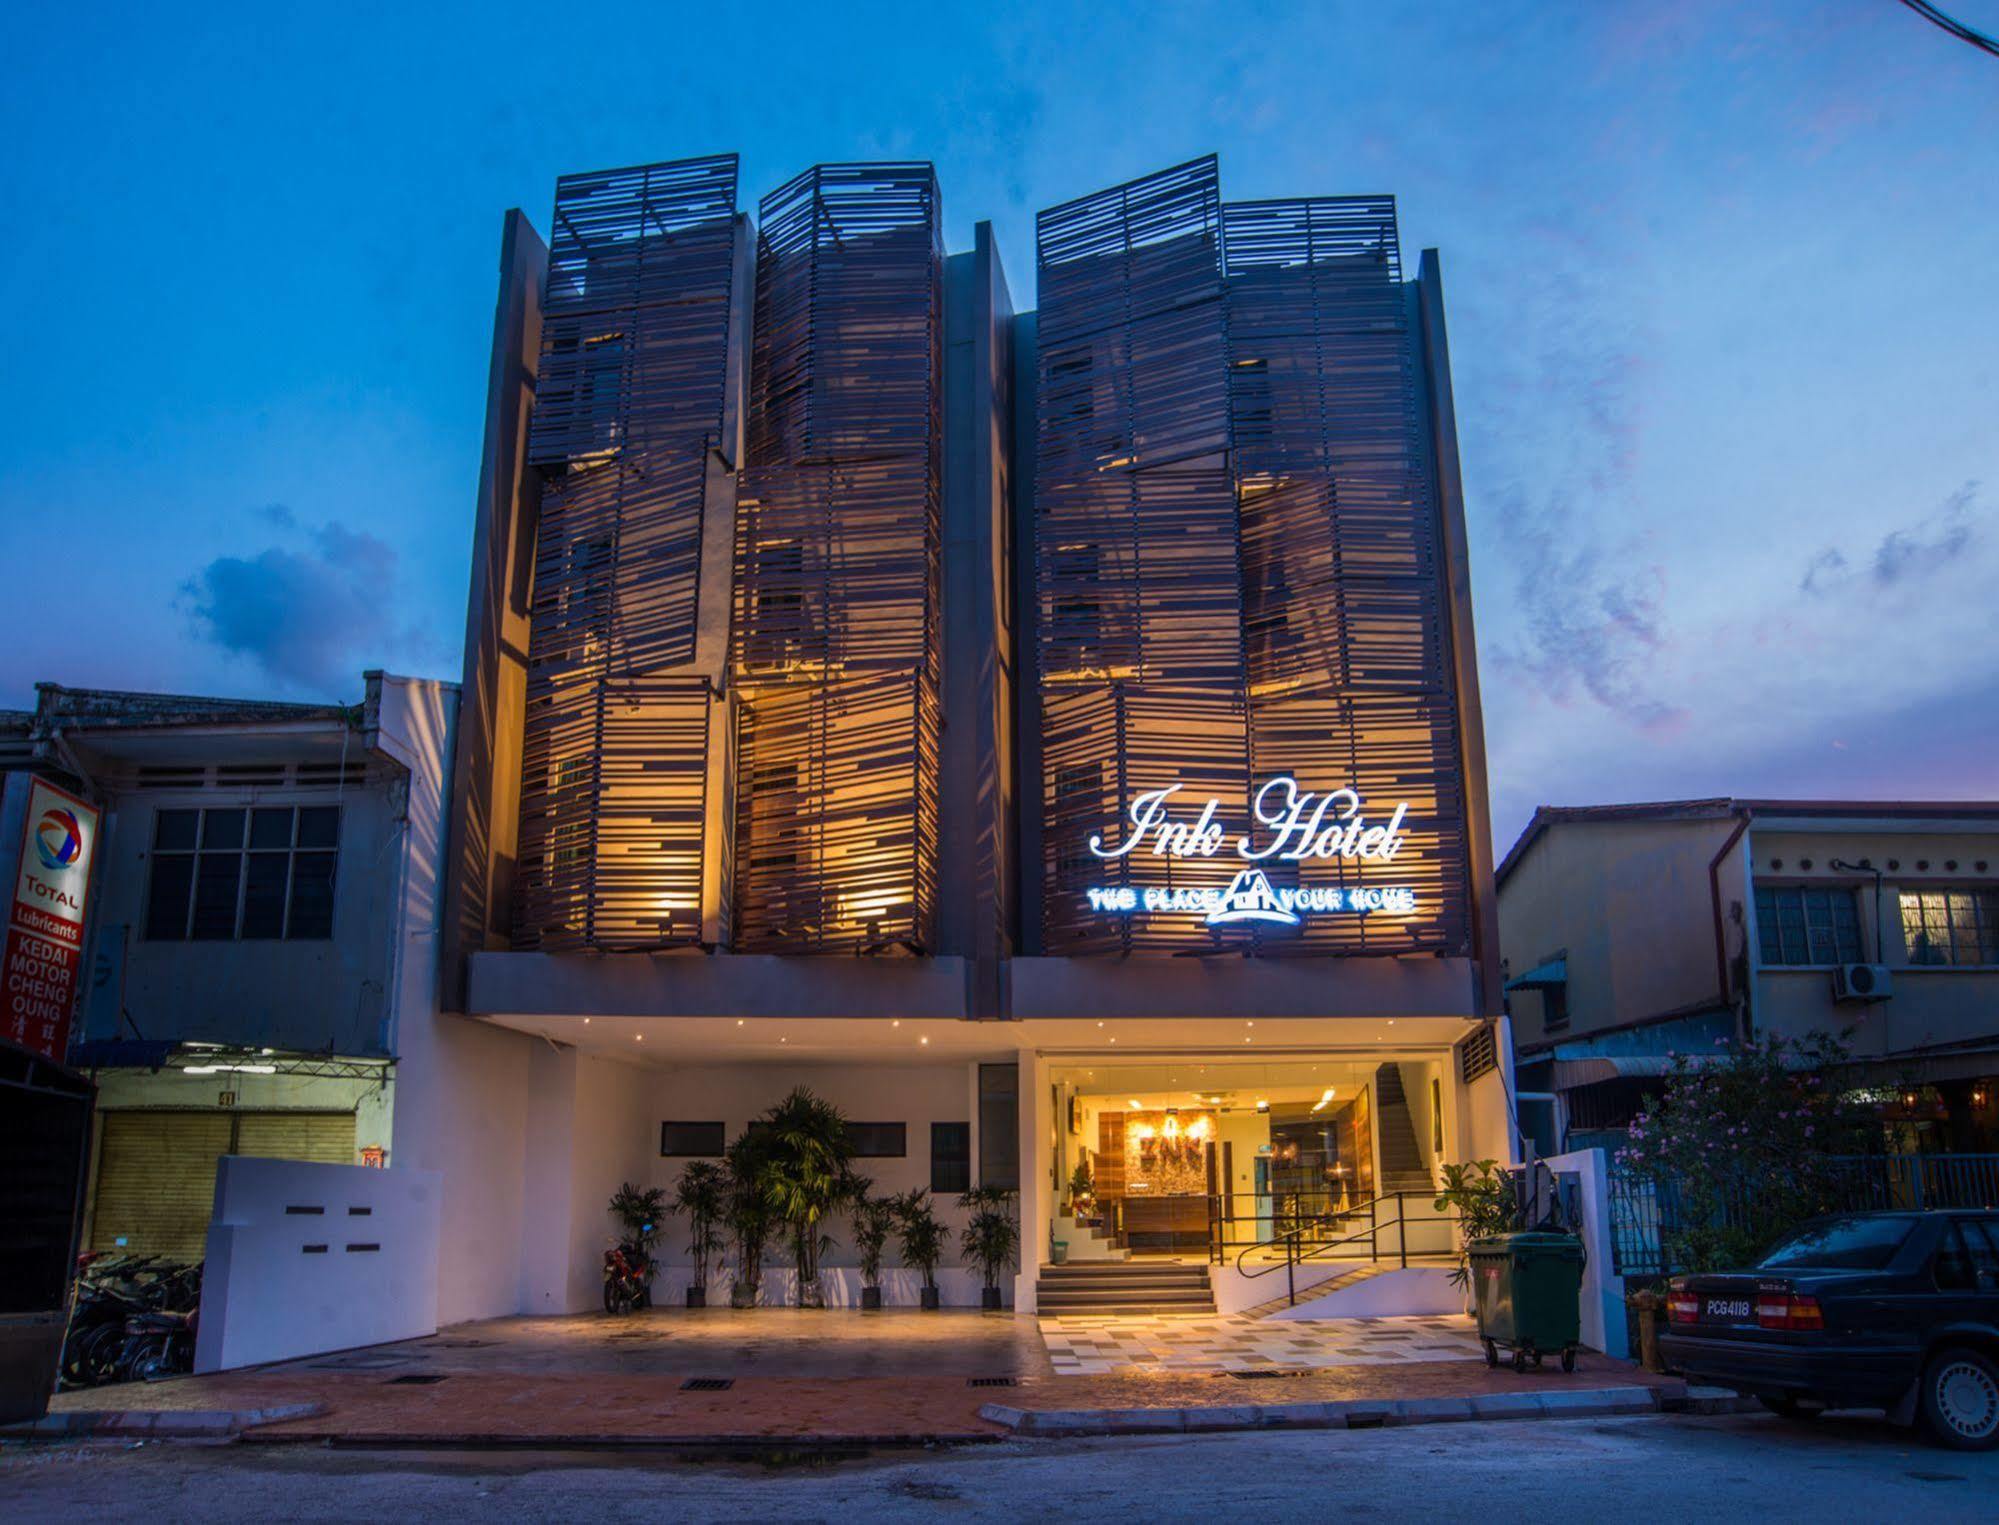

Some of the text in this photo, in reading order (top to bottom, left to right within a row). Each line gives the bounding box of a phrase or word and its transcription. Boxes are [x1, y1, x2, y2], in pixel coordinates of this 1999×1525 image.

[1089, 777, 1408, 860] Ink Hotel
[26, 874, 80, 909] TOTAL
[1087, 888, 1416, 911] THE PLACE YOUR HOME
[17, 907, 78, 940] Lubricants
[19, 937, 69, 965] KEDAI
[11, 954, 71, 985] MOTOR
[9, 975, 67, 1002] CHENG
[12, 997, 61, 1021] OUNG
[1707, 1300, 1750, 1317] PCG4118
